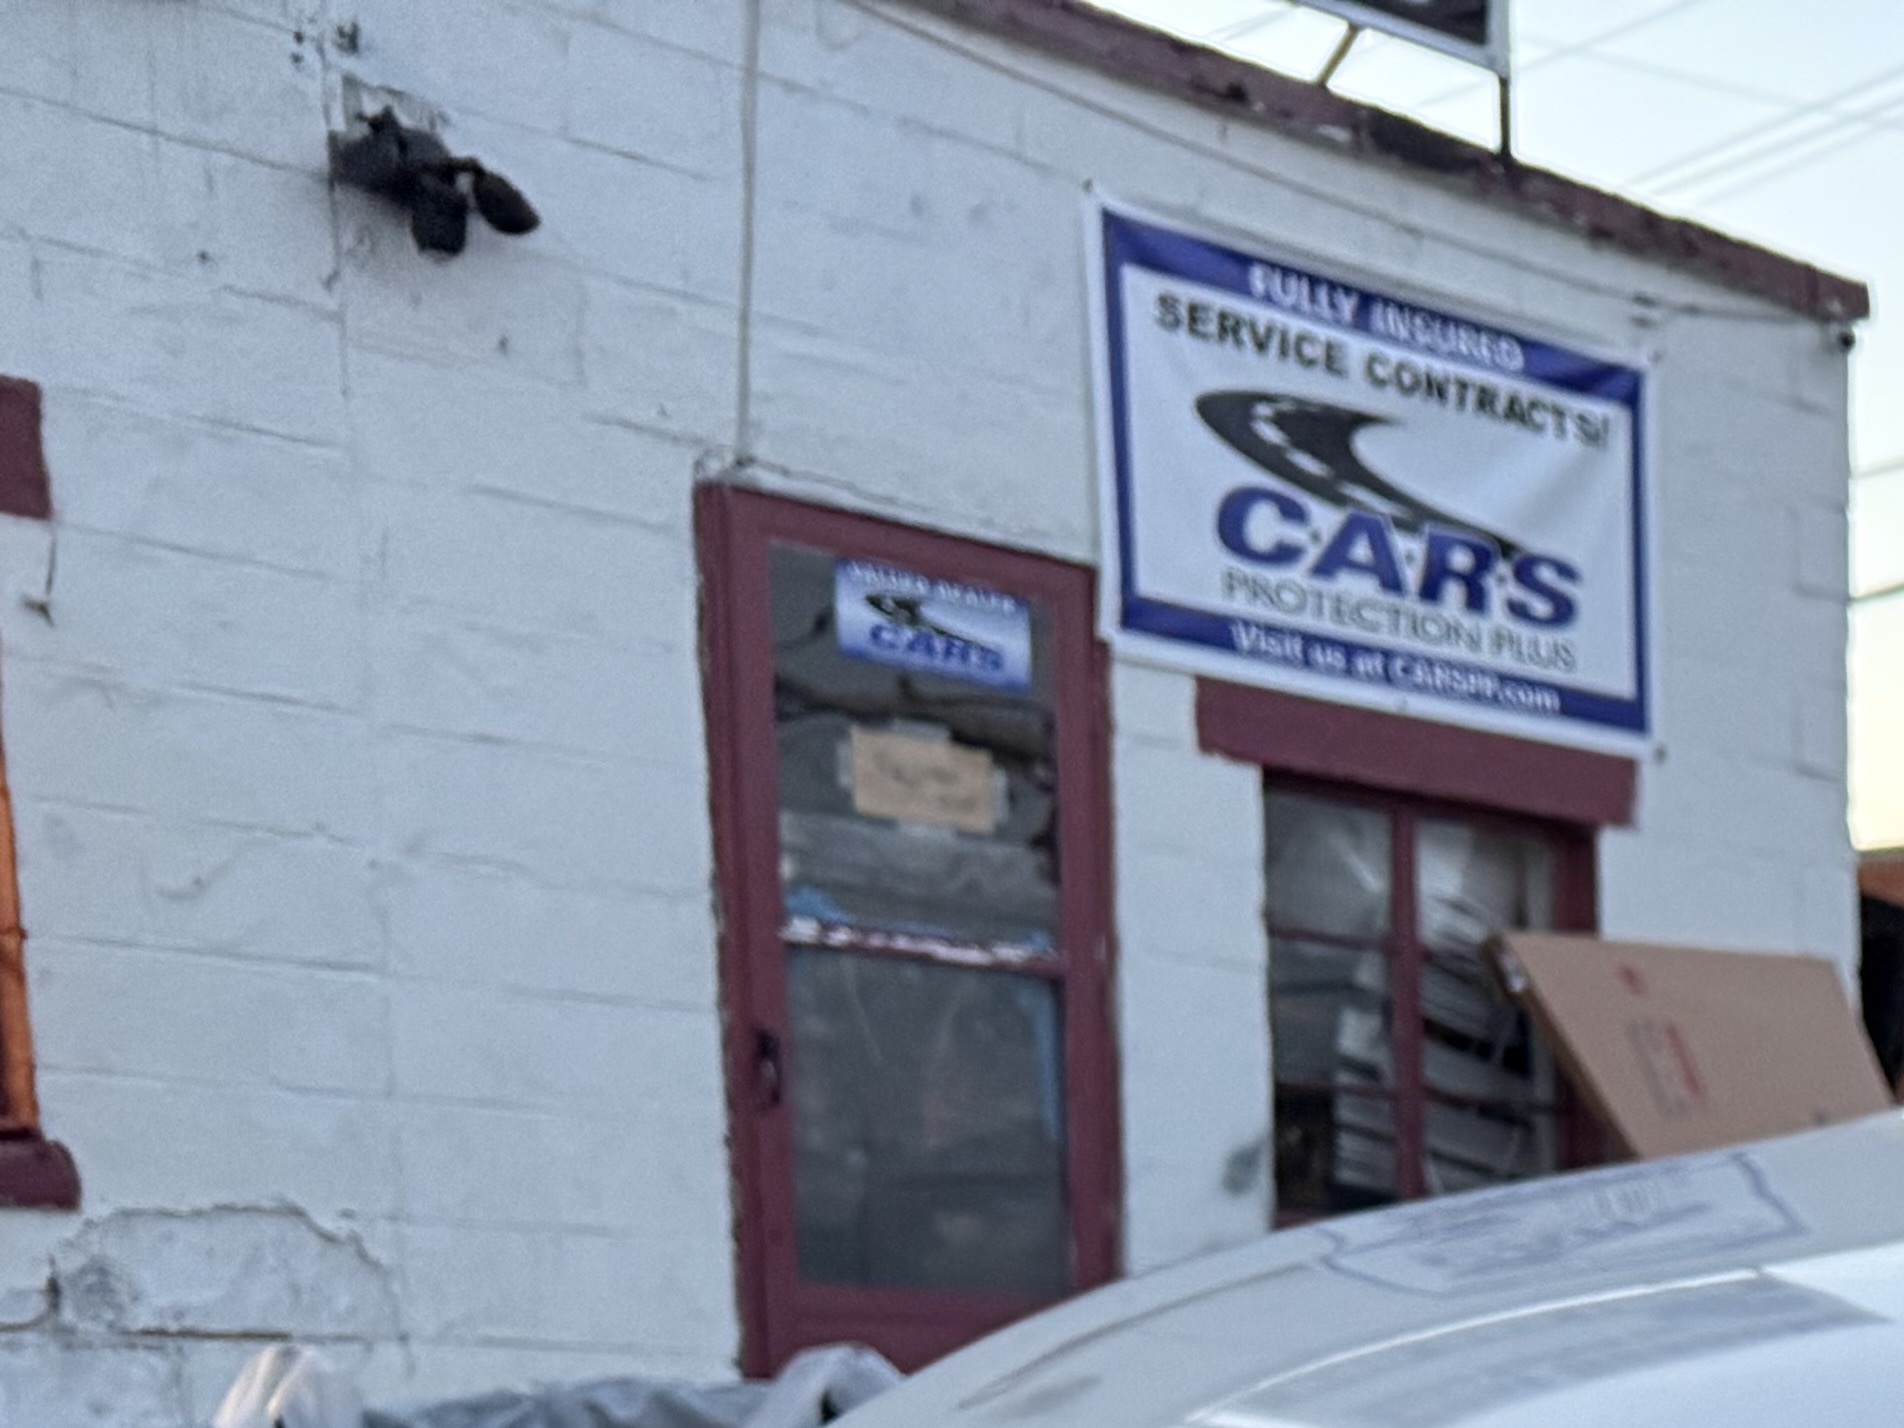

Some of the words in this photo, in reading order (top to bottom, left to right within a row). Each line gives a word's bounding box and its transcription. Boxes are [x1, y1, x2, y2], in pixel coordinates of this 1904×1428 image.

[1154, 292, 1349, 379] SERVICE
[1249, 260, 1358, 327] FULLY
[1369, 300, 1526, 374] INSURED
[1221, 567, 1483, 652] PROTECTION
[1488, 625, 1577, 673] PLUS
[1230, 619, 1303, 660] Visit
[1306, 642, 1347, 671] us
[1354, 648, 1386, 678] at
